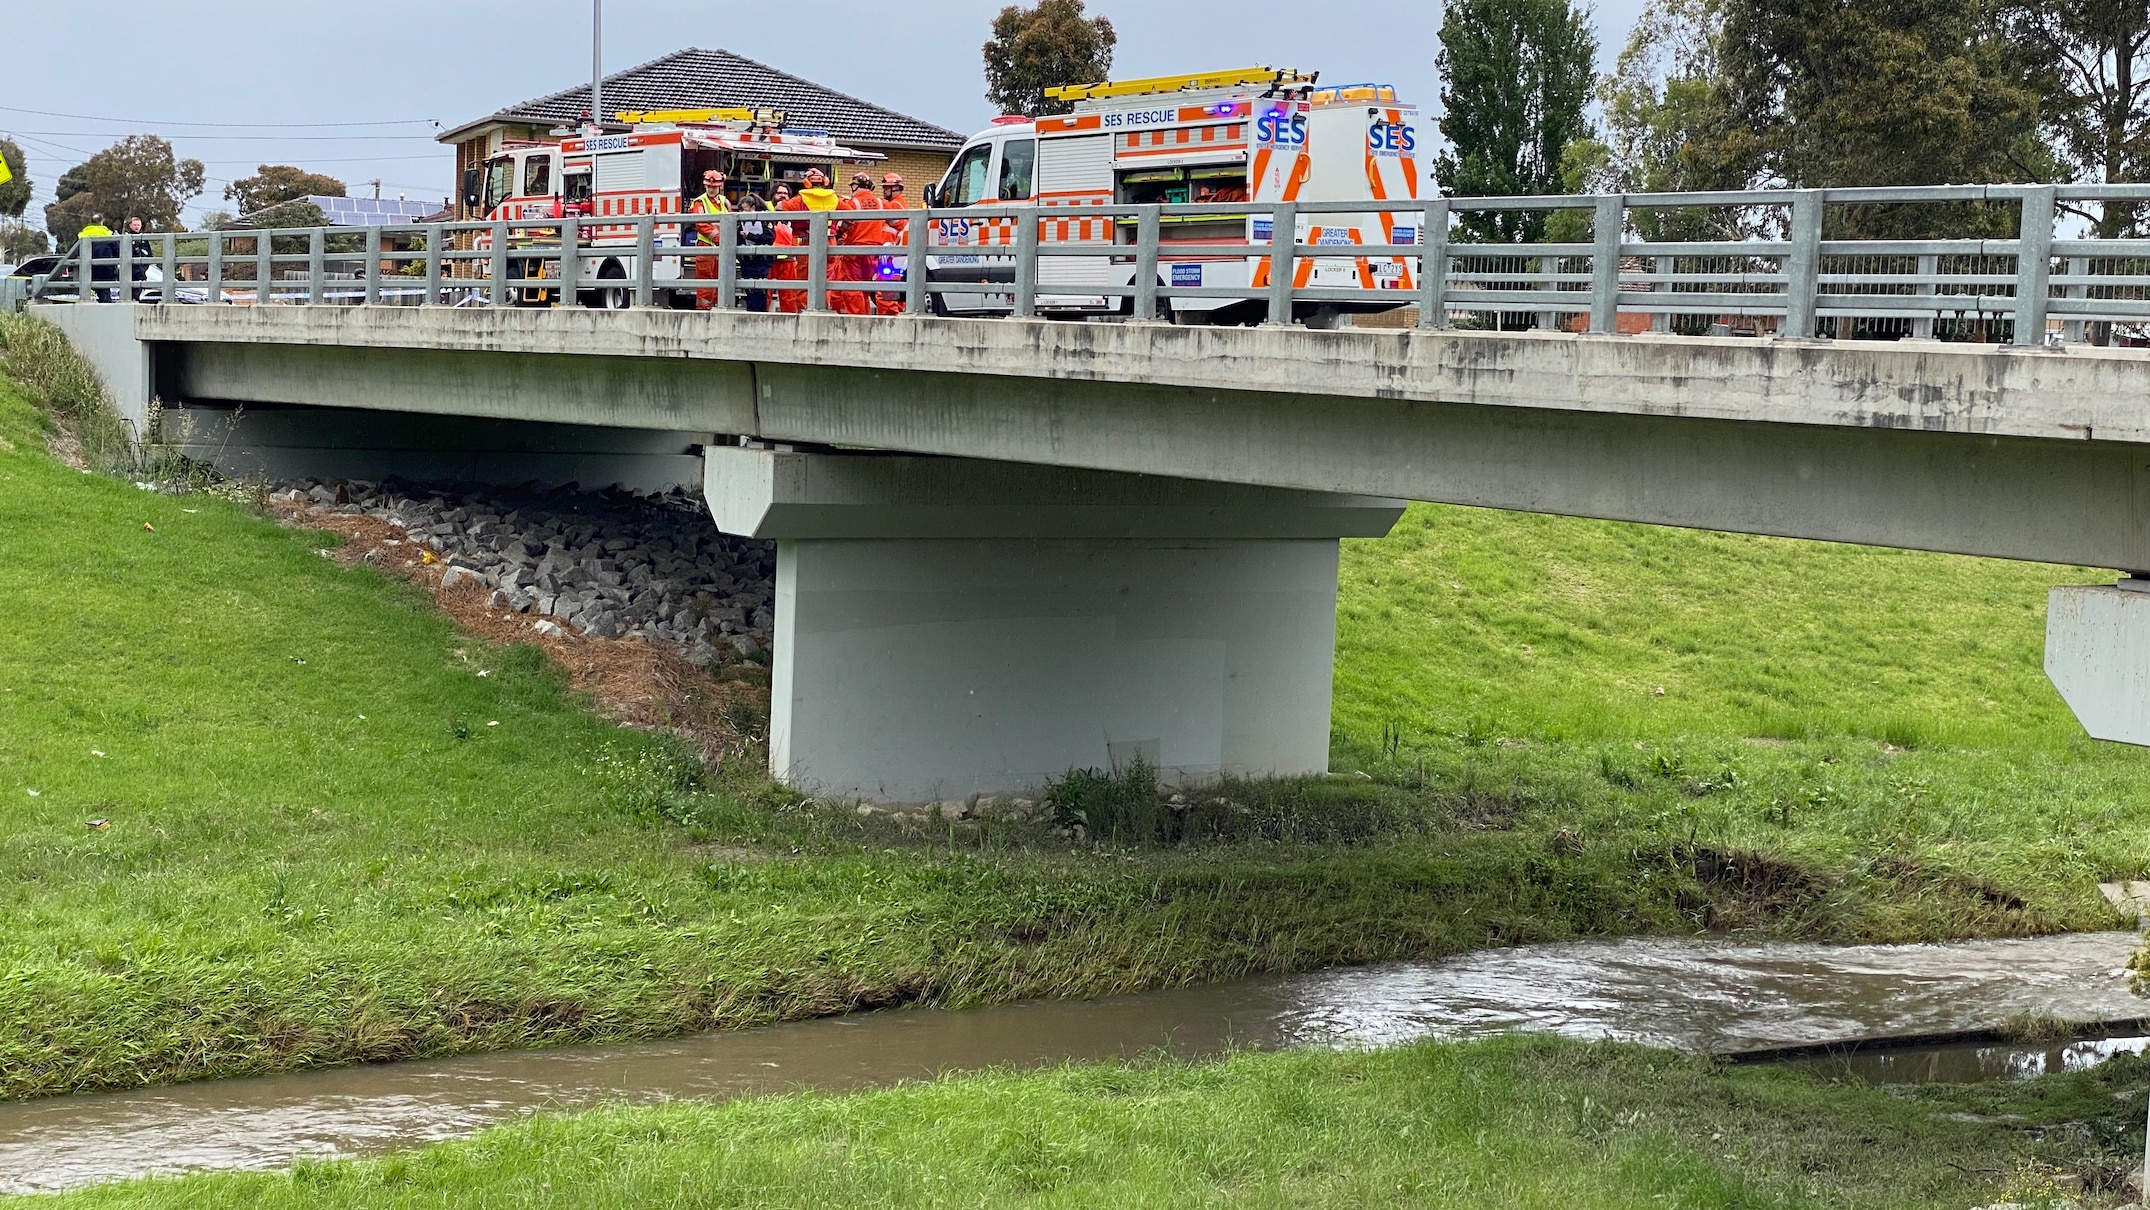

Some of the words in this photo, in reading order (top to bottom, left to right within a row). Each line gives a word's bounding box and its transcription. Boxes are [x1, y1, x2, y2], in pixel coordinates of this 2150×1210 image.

[1104, 113, 1122, 127] SES
[1127, 109, 1175, 125] RESCUE
[1257, 117, 1306, 144] SES
[1369, 125, 1415, 151] SES
[586, 140, 597, 151] SES
[598, 137, 627, 149] RESCUE
[862, 200, 878, 208] SES
[940, 218, 969, 236] SES
[1322, 228, 1348, 238] GREATER
